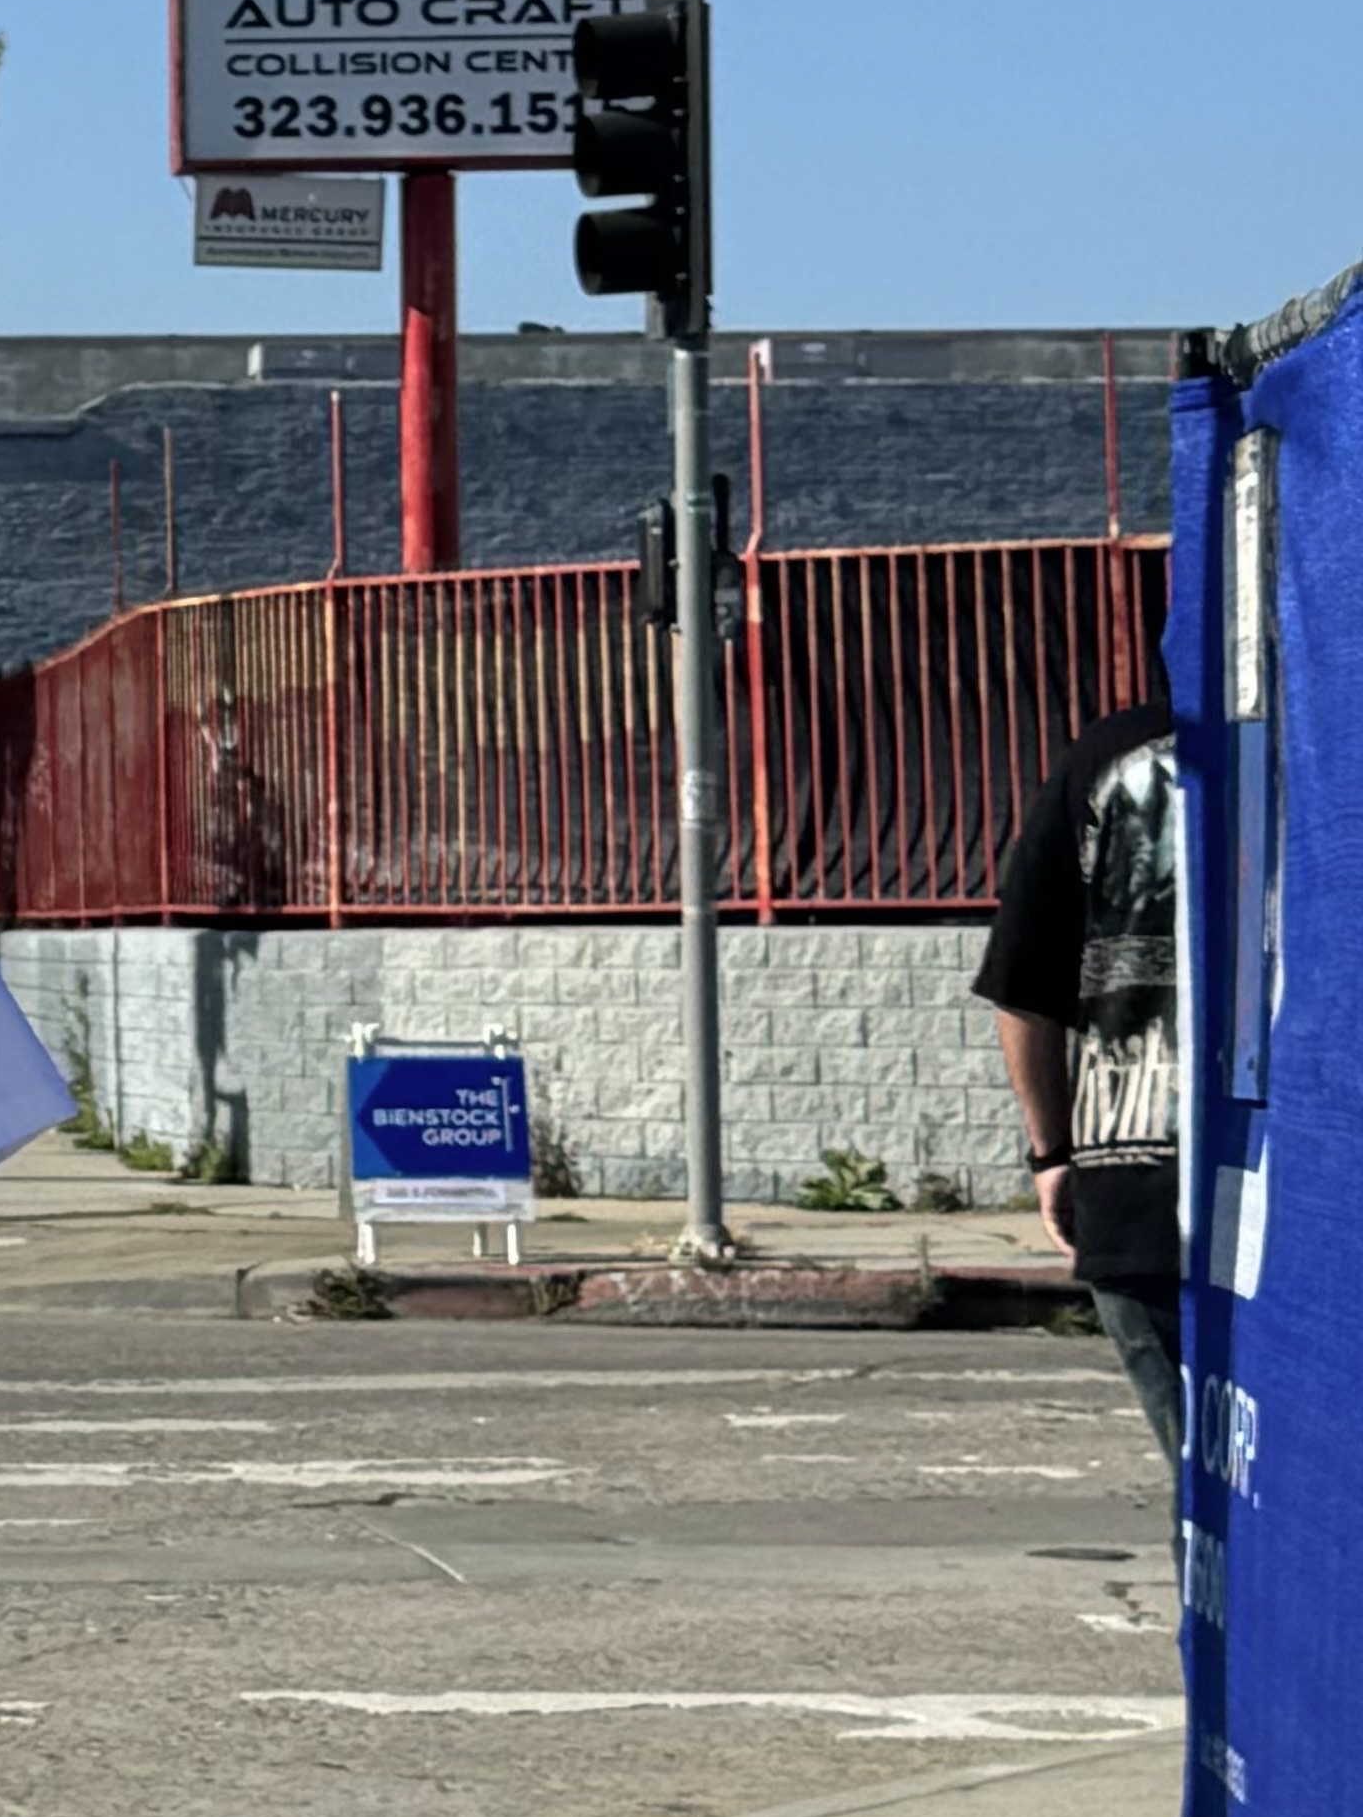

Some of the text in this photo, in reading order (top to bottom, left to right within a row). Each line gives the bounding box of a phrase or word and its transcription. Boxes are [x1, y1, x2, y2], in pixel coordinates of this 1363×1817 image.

[225, 49, 575, 78] COLLISION CENT
[232, 92, 580, 138] 323.936.15
[261, 205, 370, 224] MERCURY
[456, 1088, 499, 1106] THE
[422, 1127, 502, 1147] GROUP
